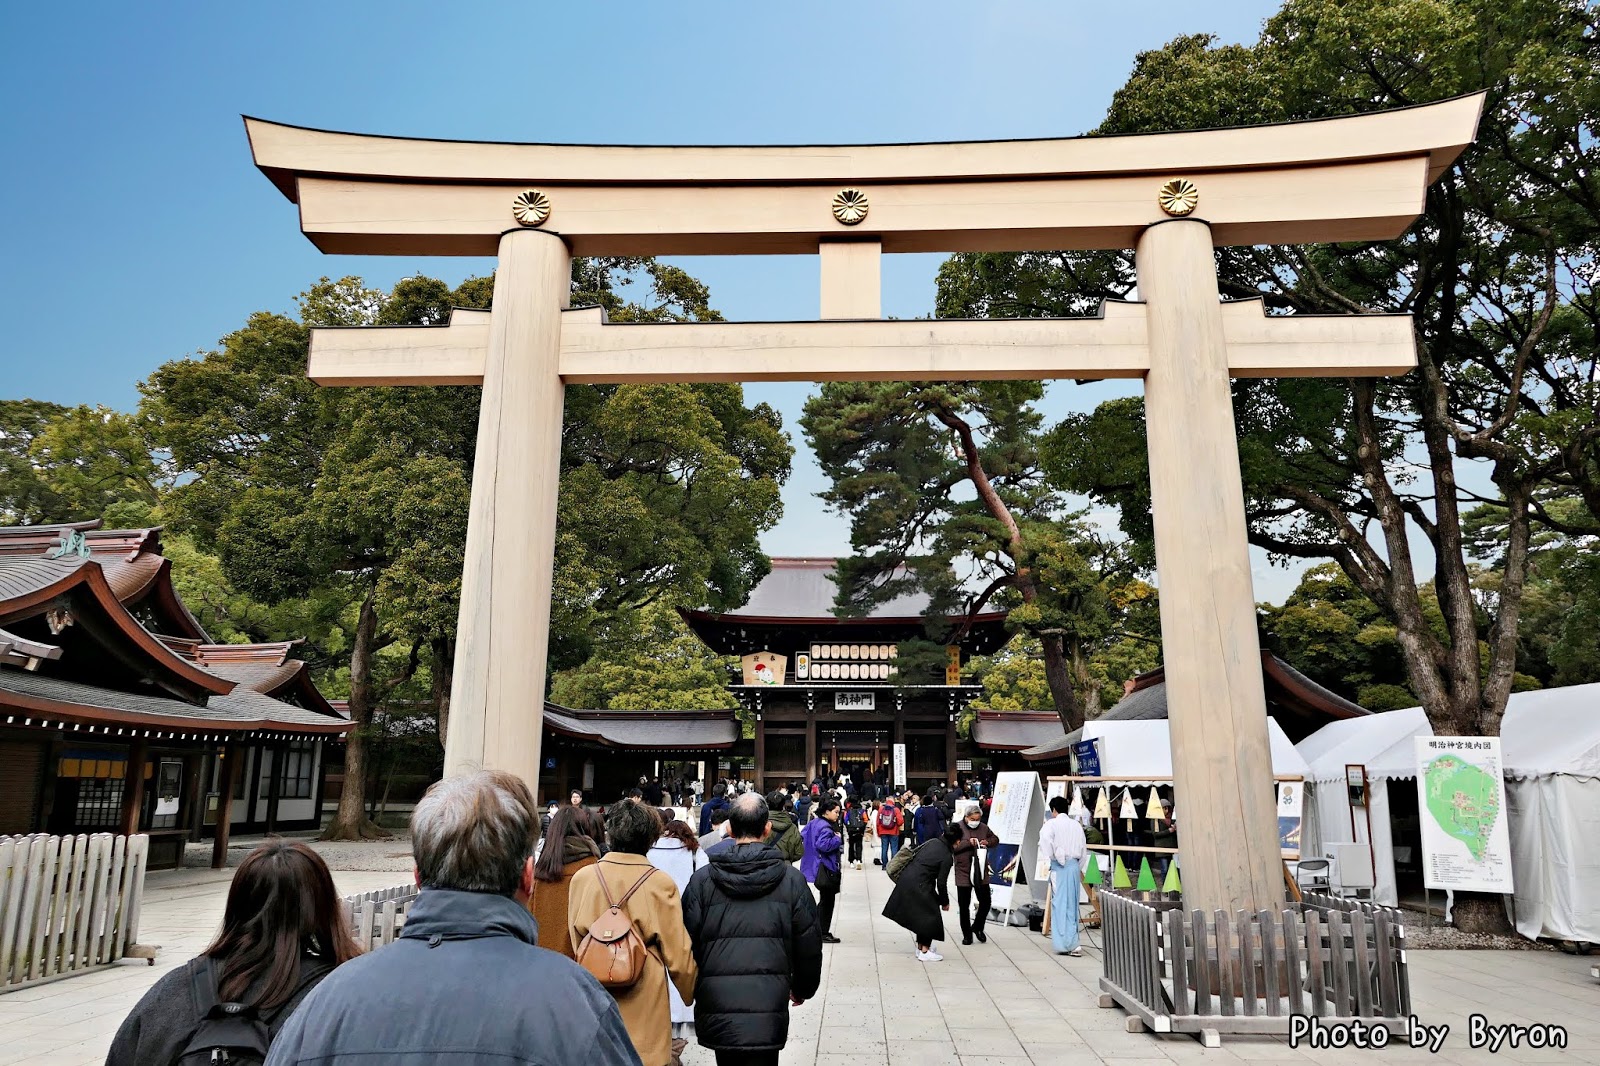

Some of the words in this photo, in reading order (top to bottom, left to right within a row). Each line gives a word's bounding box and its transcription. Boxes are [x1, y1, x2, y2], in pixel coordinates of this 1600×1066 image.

[837, 692, 873, 706] 南神門
[1428, 740, 1492, 750] 明治神宮境内図
